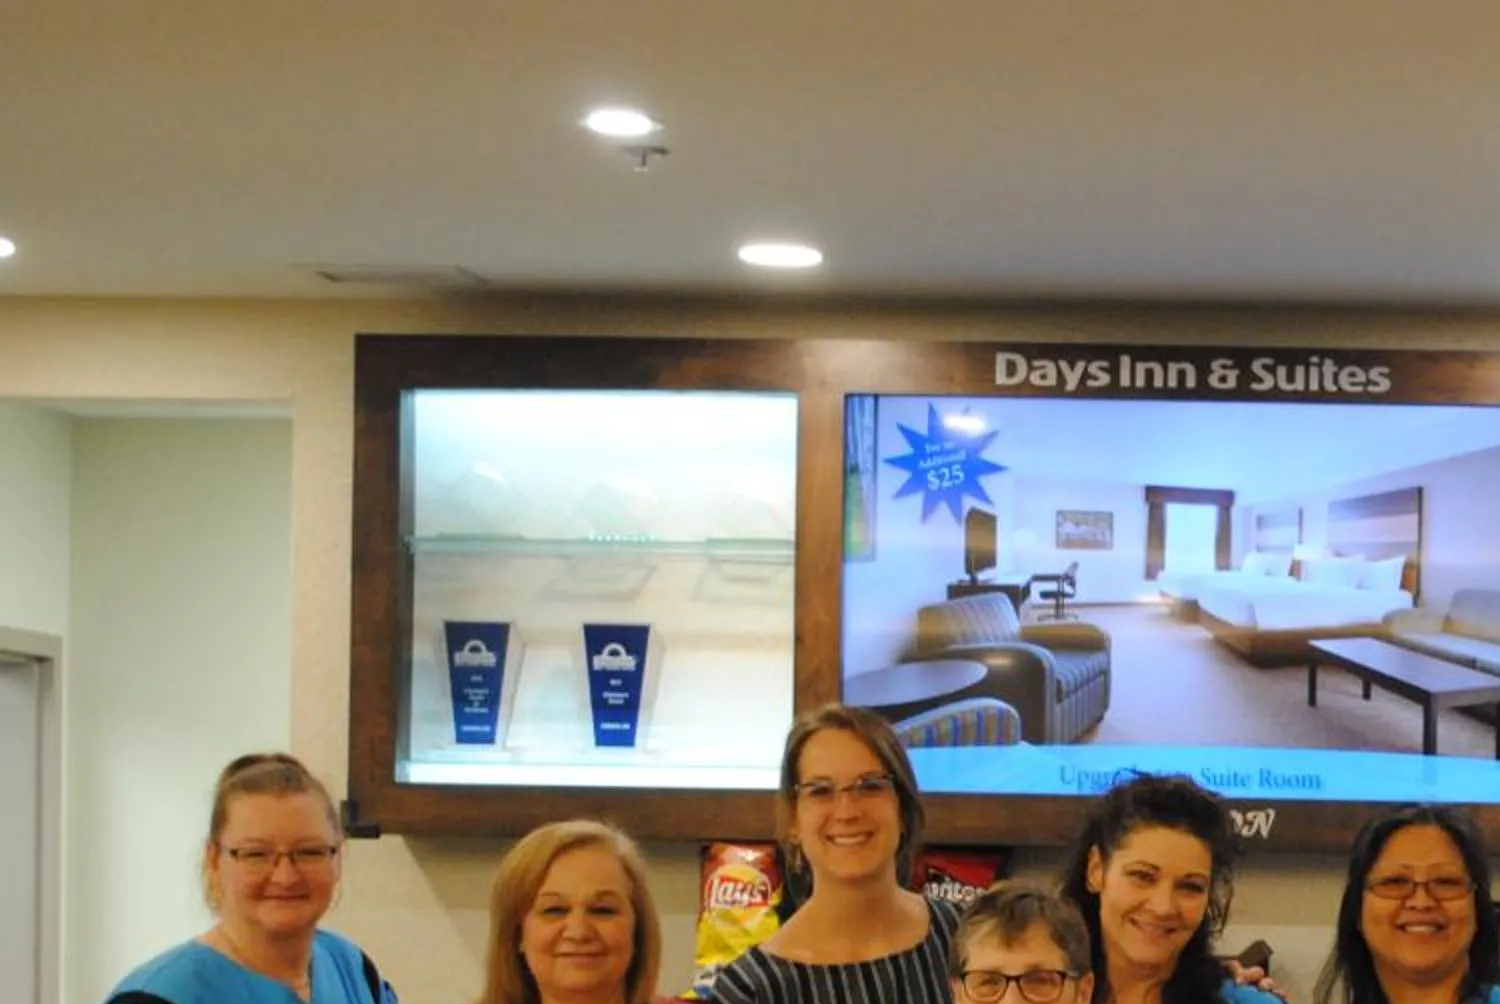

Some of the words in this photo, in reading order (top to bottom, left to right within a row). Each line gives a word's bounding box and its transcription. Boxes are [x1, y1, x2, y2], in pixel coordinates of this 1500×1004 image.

[995, 352, 1111, 392] Days
[1119, 355, 1196, 389] Inn
[1207, 358, 1239, 390] &
[1250, 356, 1392, 393] Suites
[926, 464, 965, 491] $25
[1200, 766, 1250, 787] Suite
[1258, 767, 1322, 790] Room
[923, 875, 986, 902] orito
